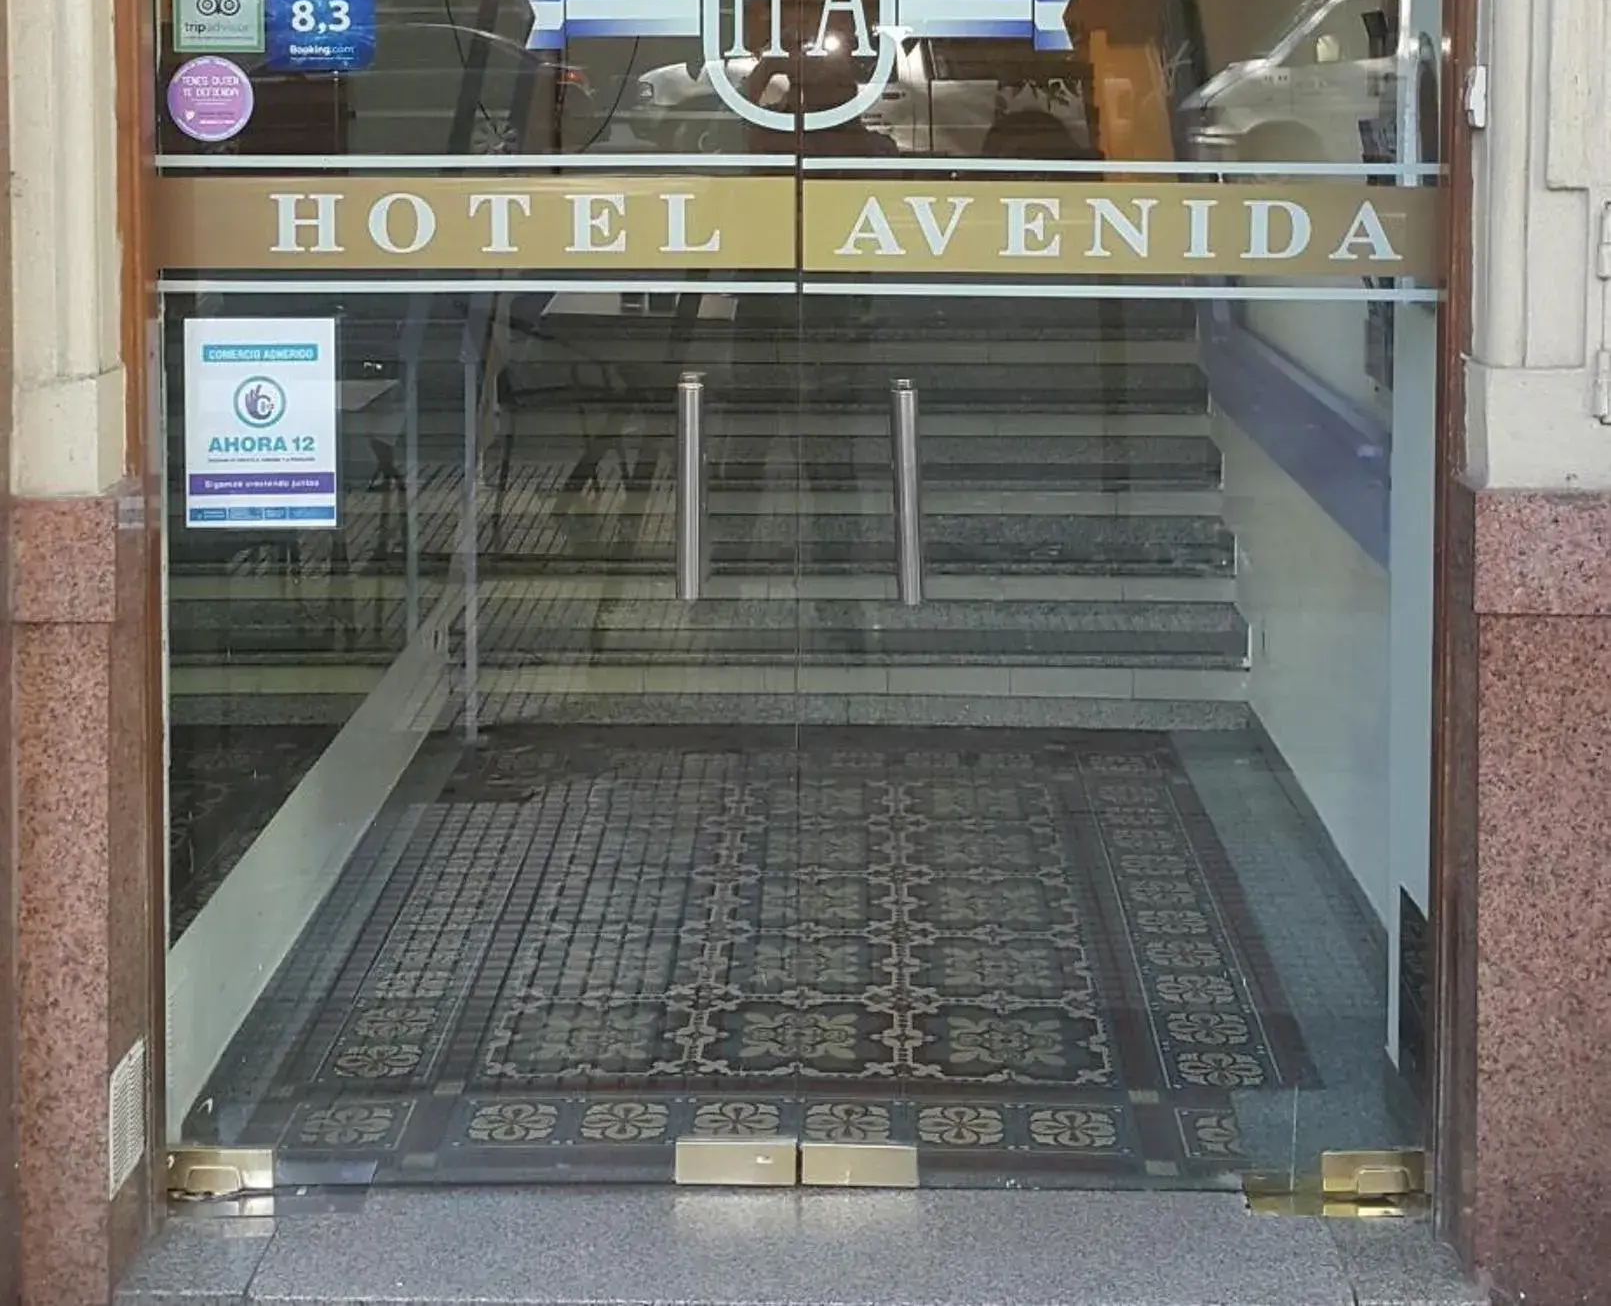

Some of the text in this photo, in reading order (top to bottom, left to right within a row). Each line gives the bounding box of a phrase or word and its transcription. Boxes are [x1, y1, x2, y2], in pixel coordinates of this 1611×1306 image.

[291, 0, 351, 34] 8,3
[289, 44, 354, 56] Booking.com
[269, 192, 1403, 260] HOTEL AVENIDA
[208, 348, 315, 360] COMERCIO ADHERIDO
[208, 435, 315, 453] AHORA 12
